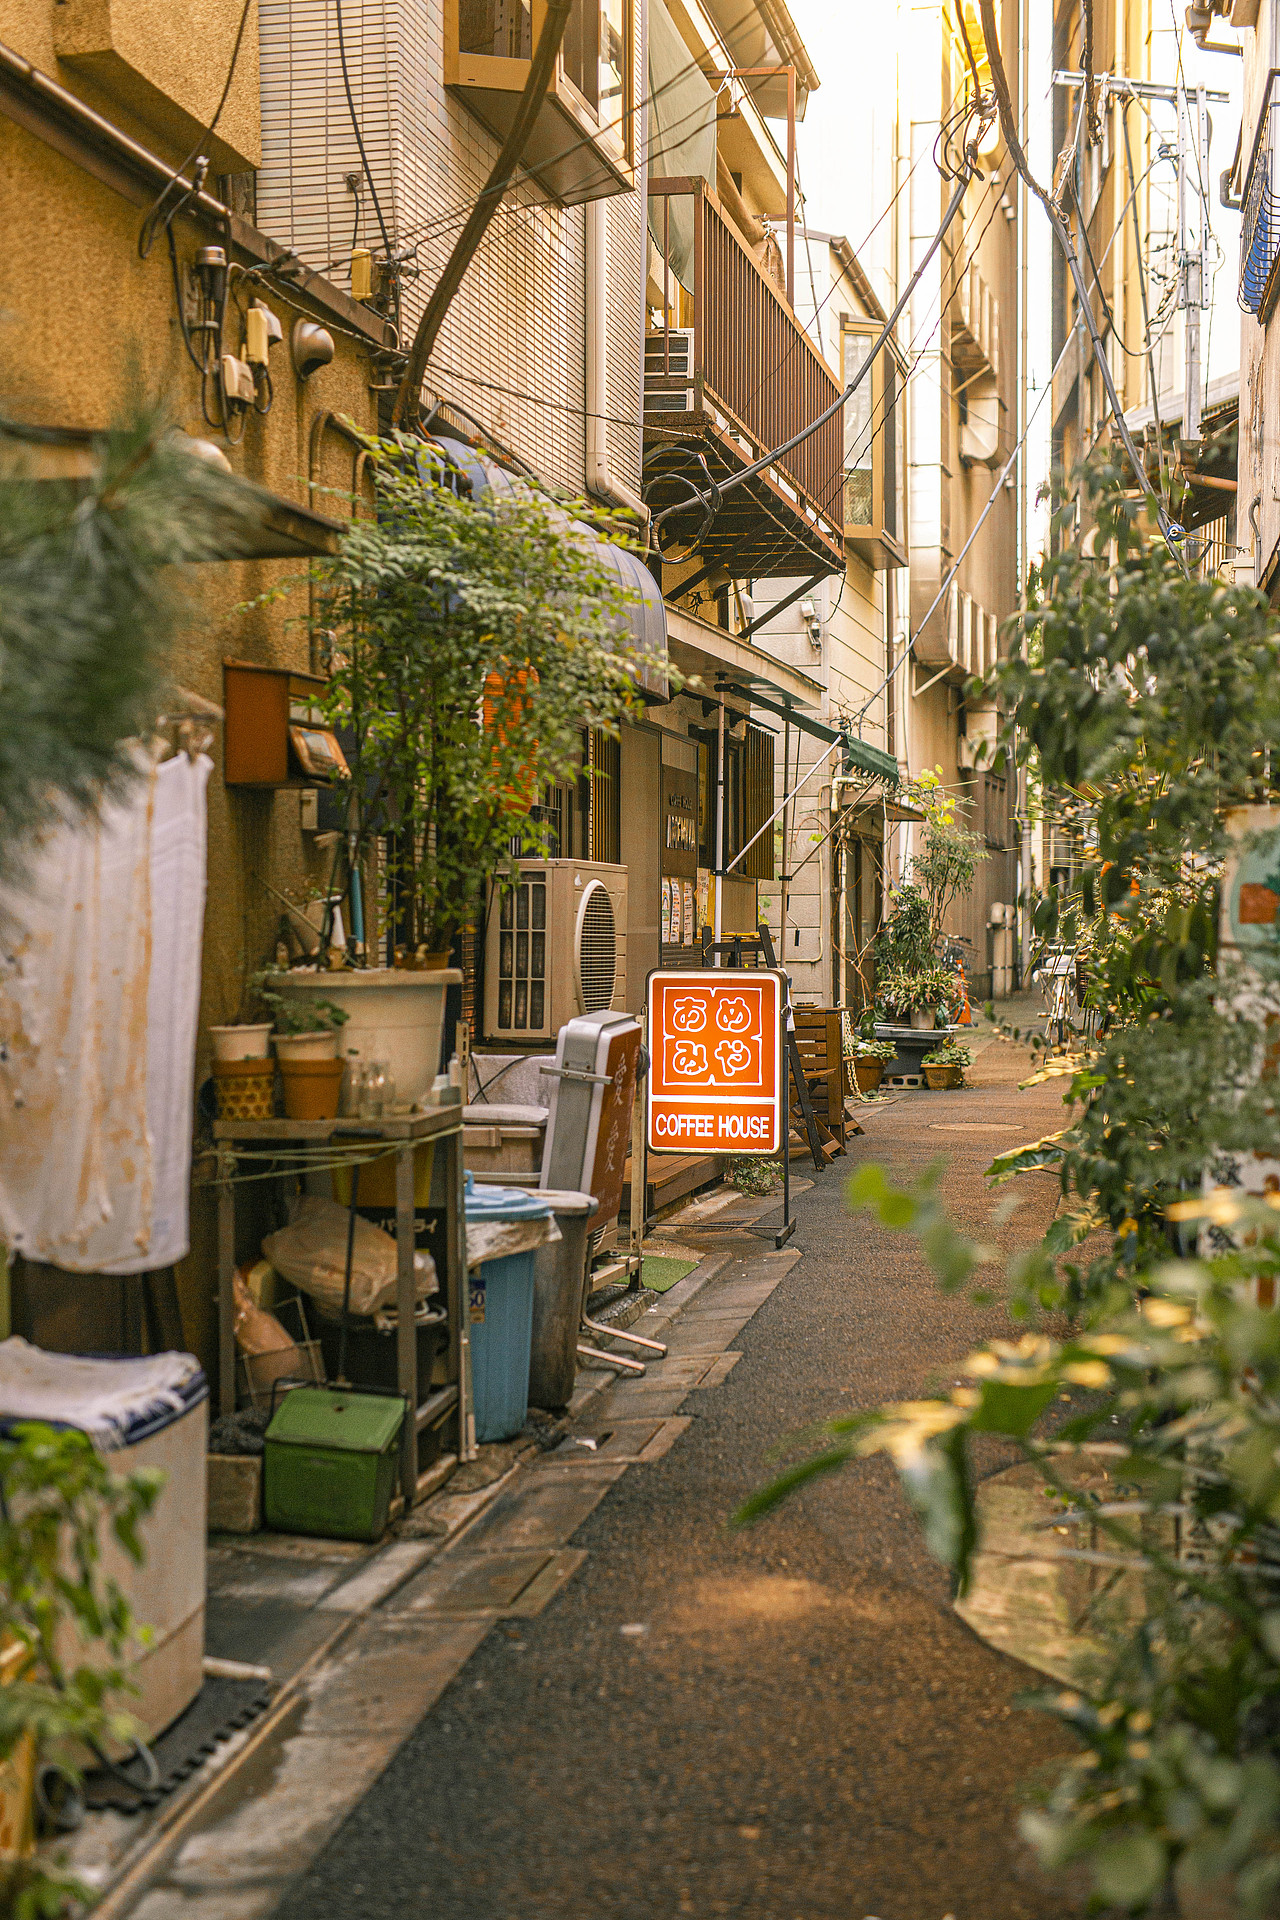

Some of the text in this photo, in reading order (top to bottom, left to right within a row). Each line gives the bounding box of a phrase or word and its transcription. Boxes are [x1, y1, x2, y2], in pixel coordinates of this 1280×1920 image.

[673, 997, 751, 1033] あめ
[673, 1040, 751, 1077] みや
[655, 1113, 770, 1139] COFFEE HOUSE
